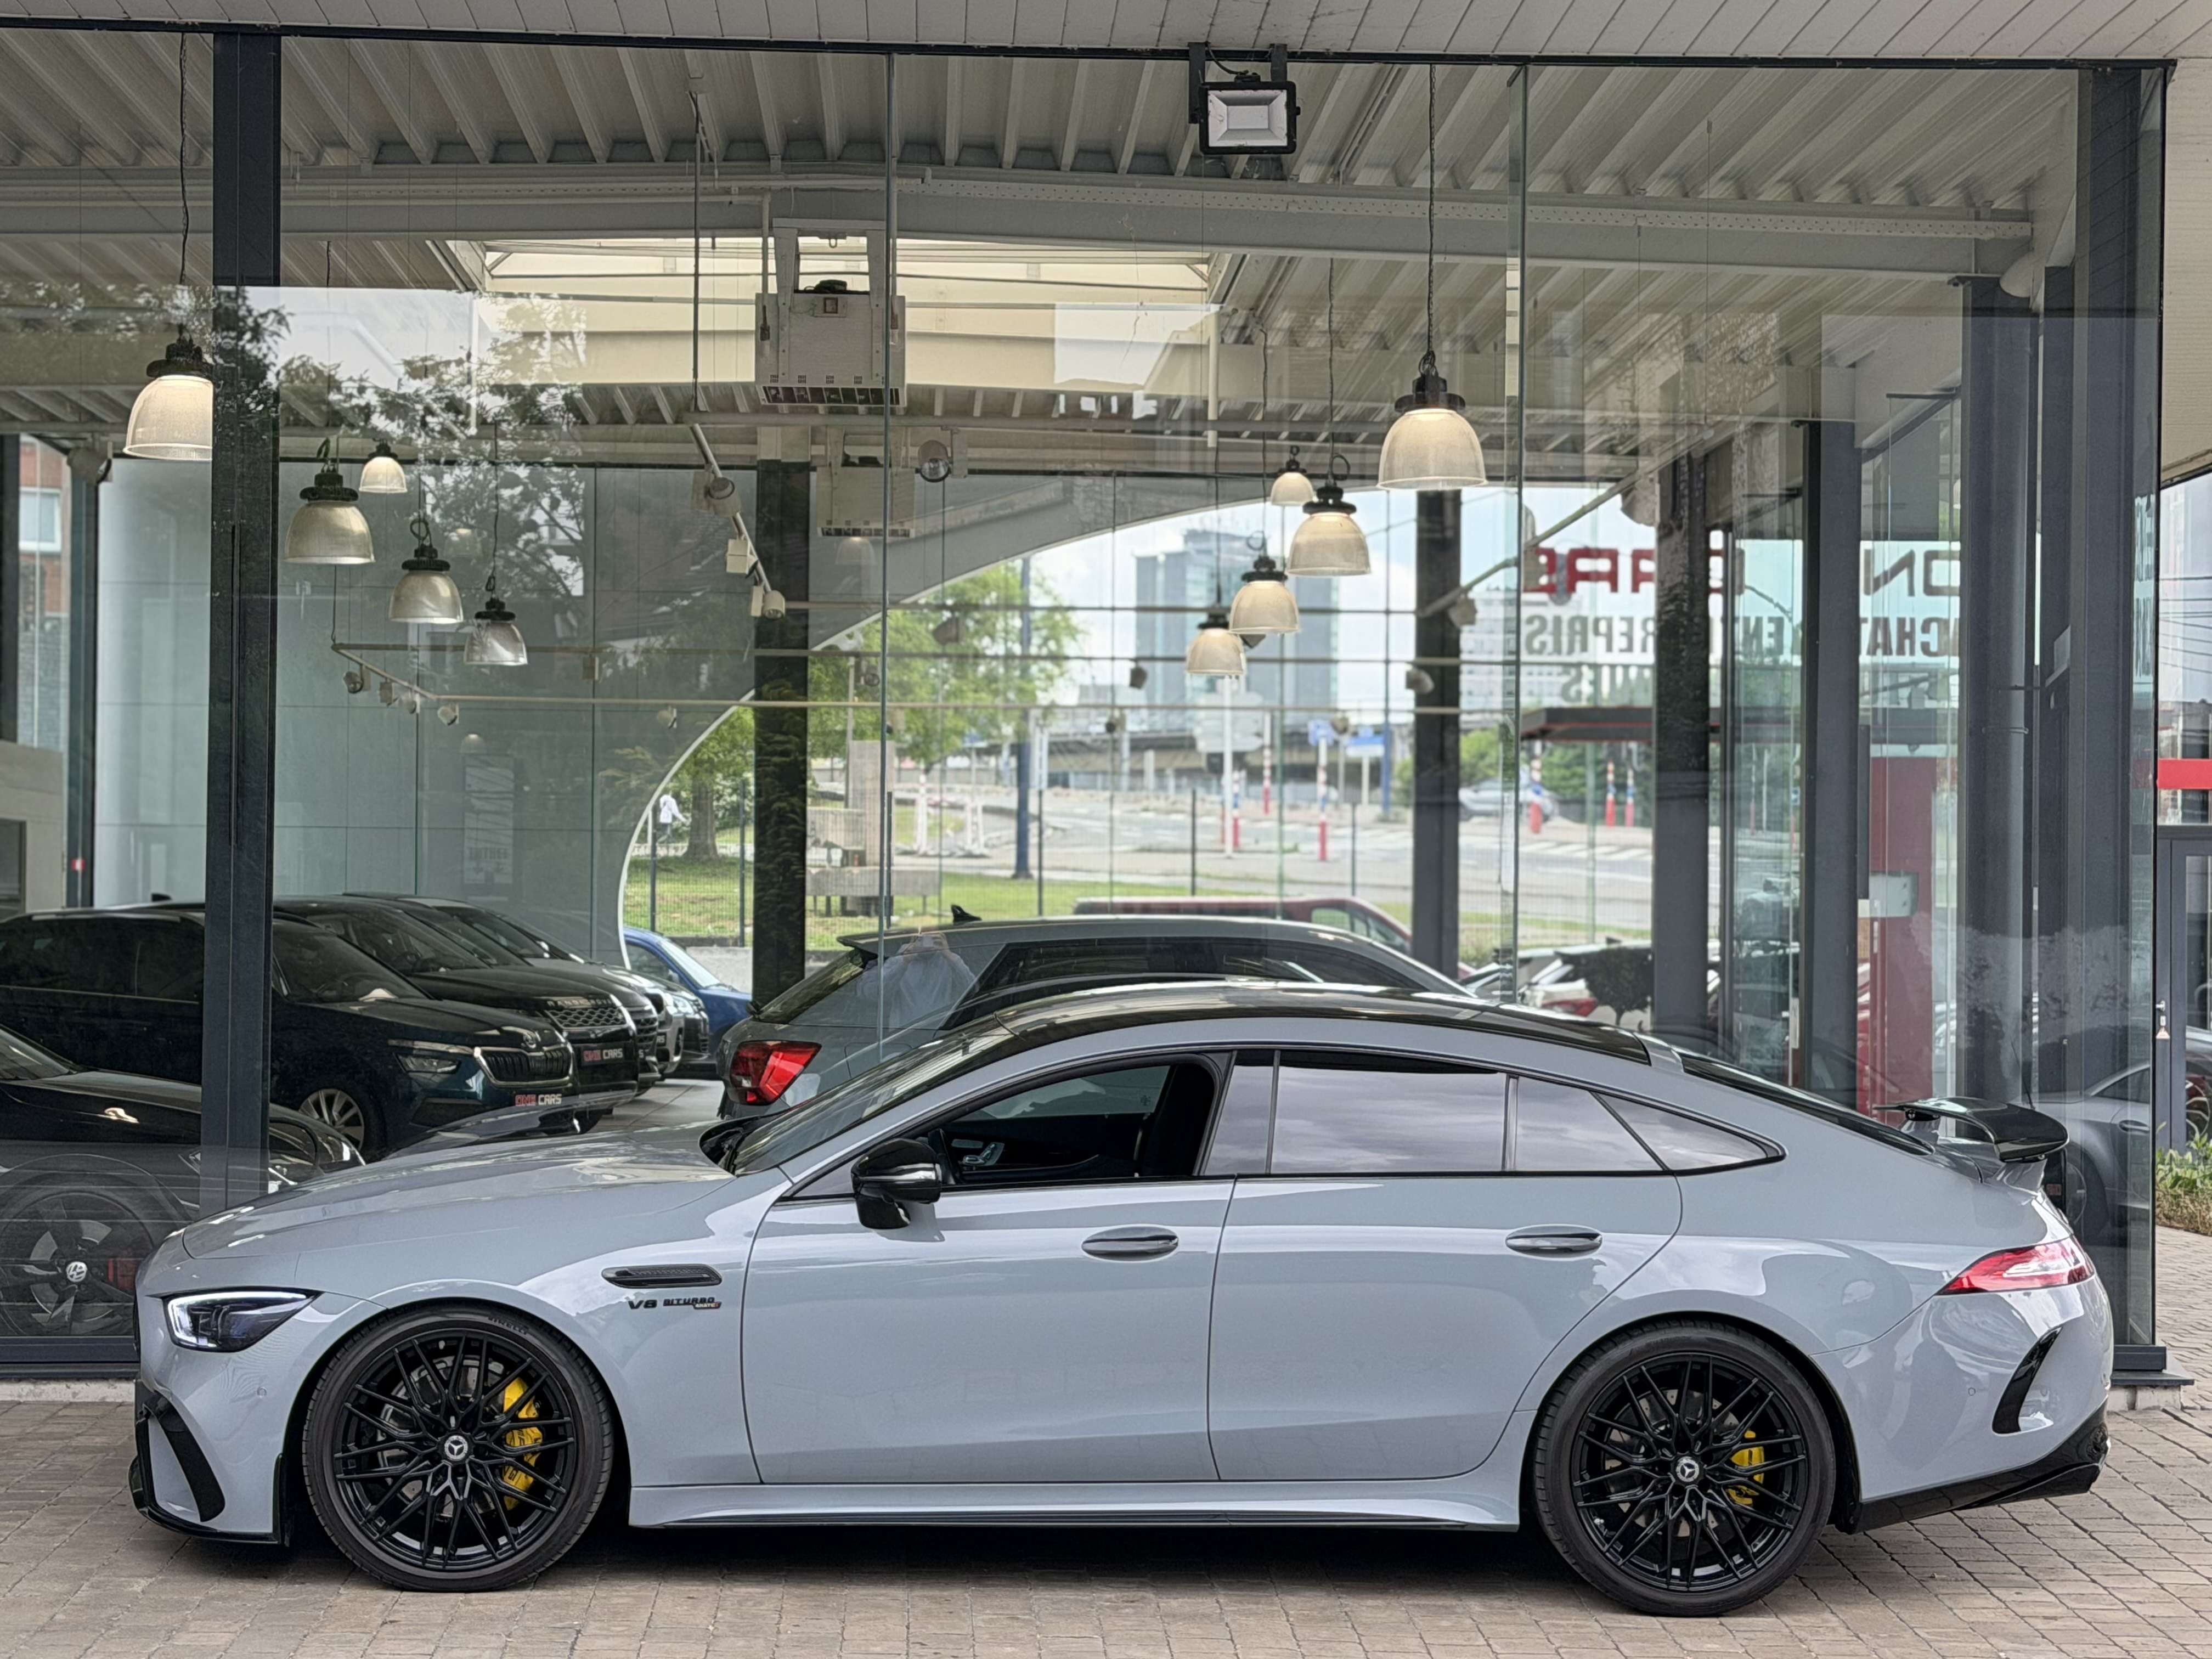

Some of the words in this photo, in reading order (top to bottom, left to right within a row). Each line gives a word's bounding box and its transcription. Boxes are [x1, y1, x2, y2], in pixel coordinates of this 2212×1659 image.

[603, 1048, 623, 1059] CARS
[515, 1094, 537, 1106] ONE
[538, 1093, 562, 1105] CARS
[628, 1299, 658, 1310] V8
[663, 1296, 715, 1306] BITURBO
